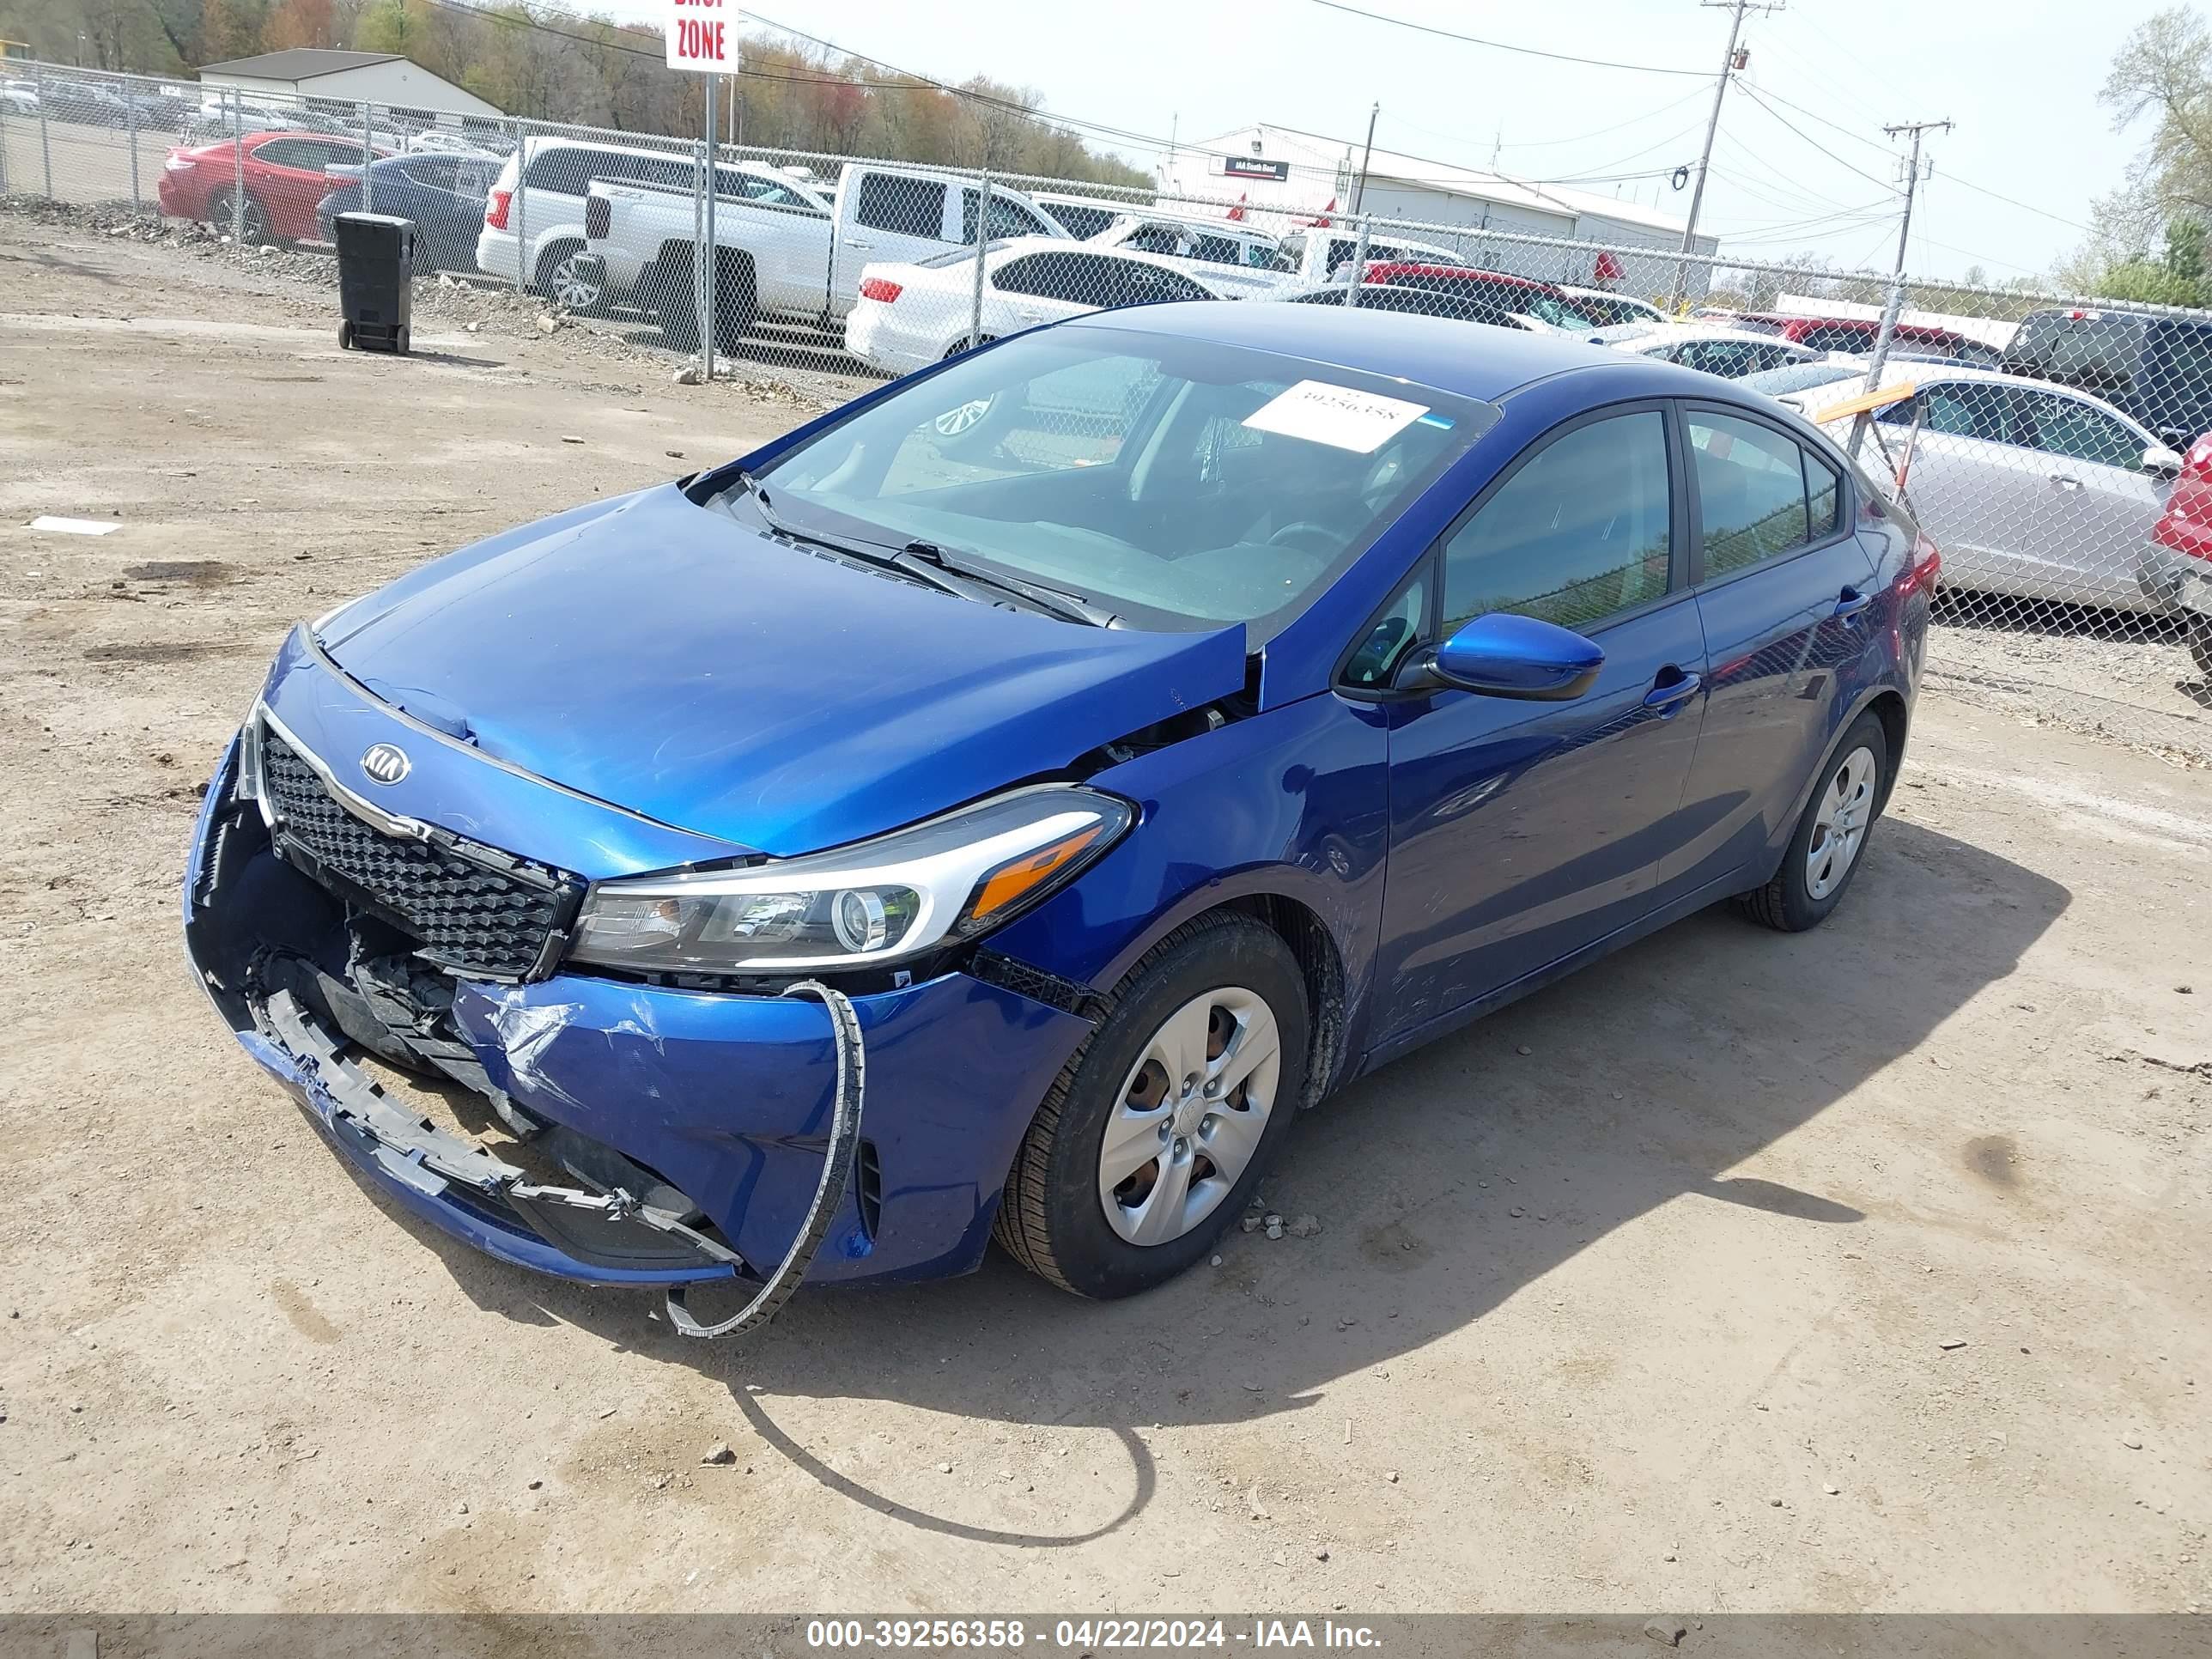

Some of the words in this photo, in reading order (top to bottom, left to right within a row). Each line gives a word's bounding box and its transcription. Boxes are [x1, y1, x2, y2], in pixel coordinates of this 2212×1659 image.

[678, 19, 725, 60] ZONE
[1235, 161, 1246, 170] IAA
[1246, 162, 1262, 172] South
[364, 747, 400, 781] KIA
